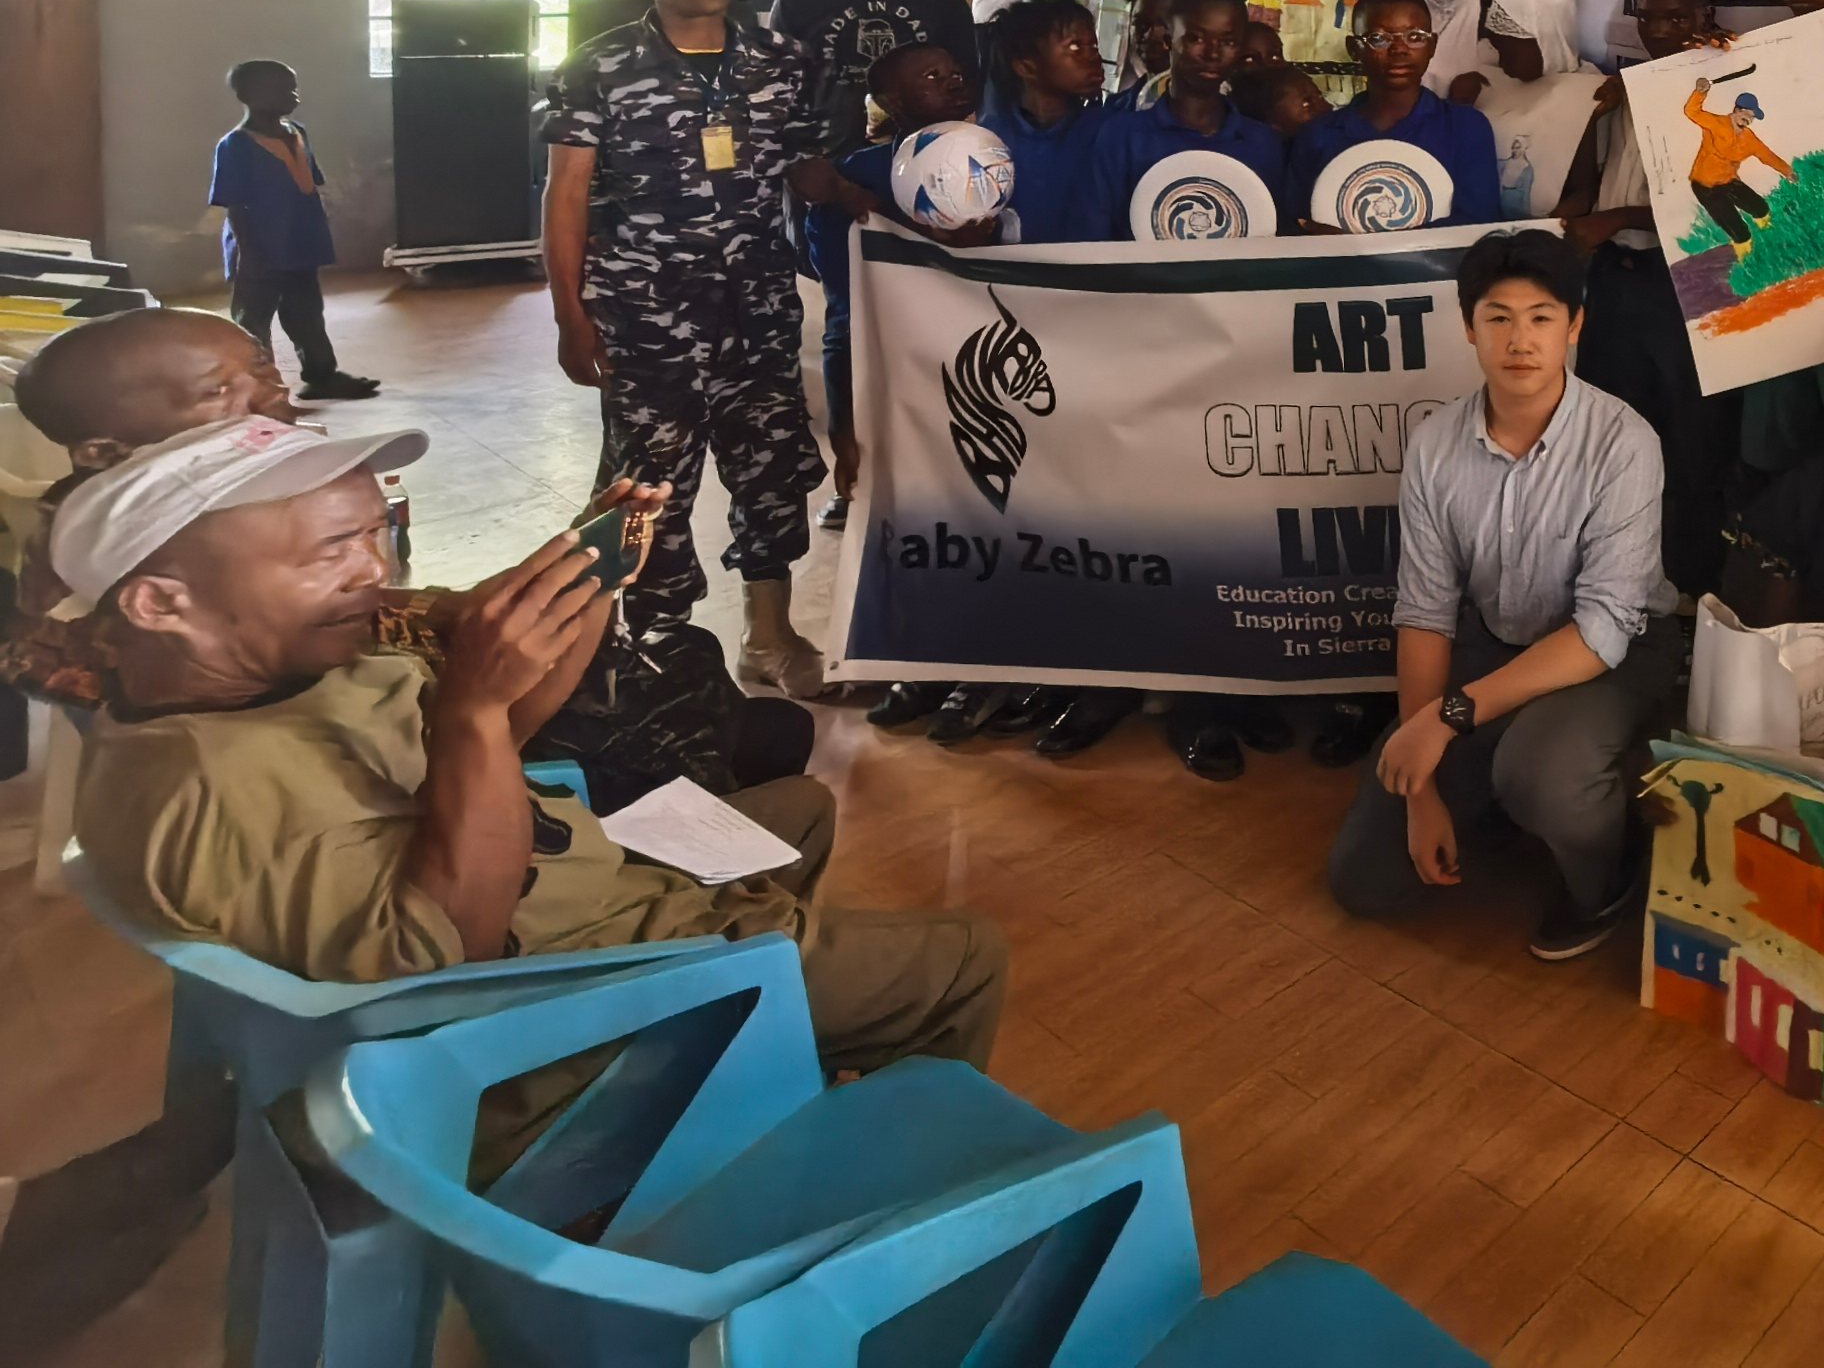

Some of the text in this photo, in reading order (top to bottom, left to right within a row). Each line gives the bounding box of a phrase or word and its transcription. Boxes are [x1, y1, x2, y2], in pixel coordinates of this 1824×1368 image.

[822, 0, 928, 60] MADE IN DAD
[1293, 295, 1434, 373] ART
[1016, 531, 1173, 587] Zebra
[1276, 505, 1400, 578] LIV
[1216, 585, 1336, 605] Education
[1232, 611, 1344, 633] Inspiring
[1283, 638, 1392, 657] In Sierra
